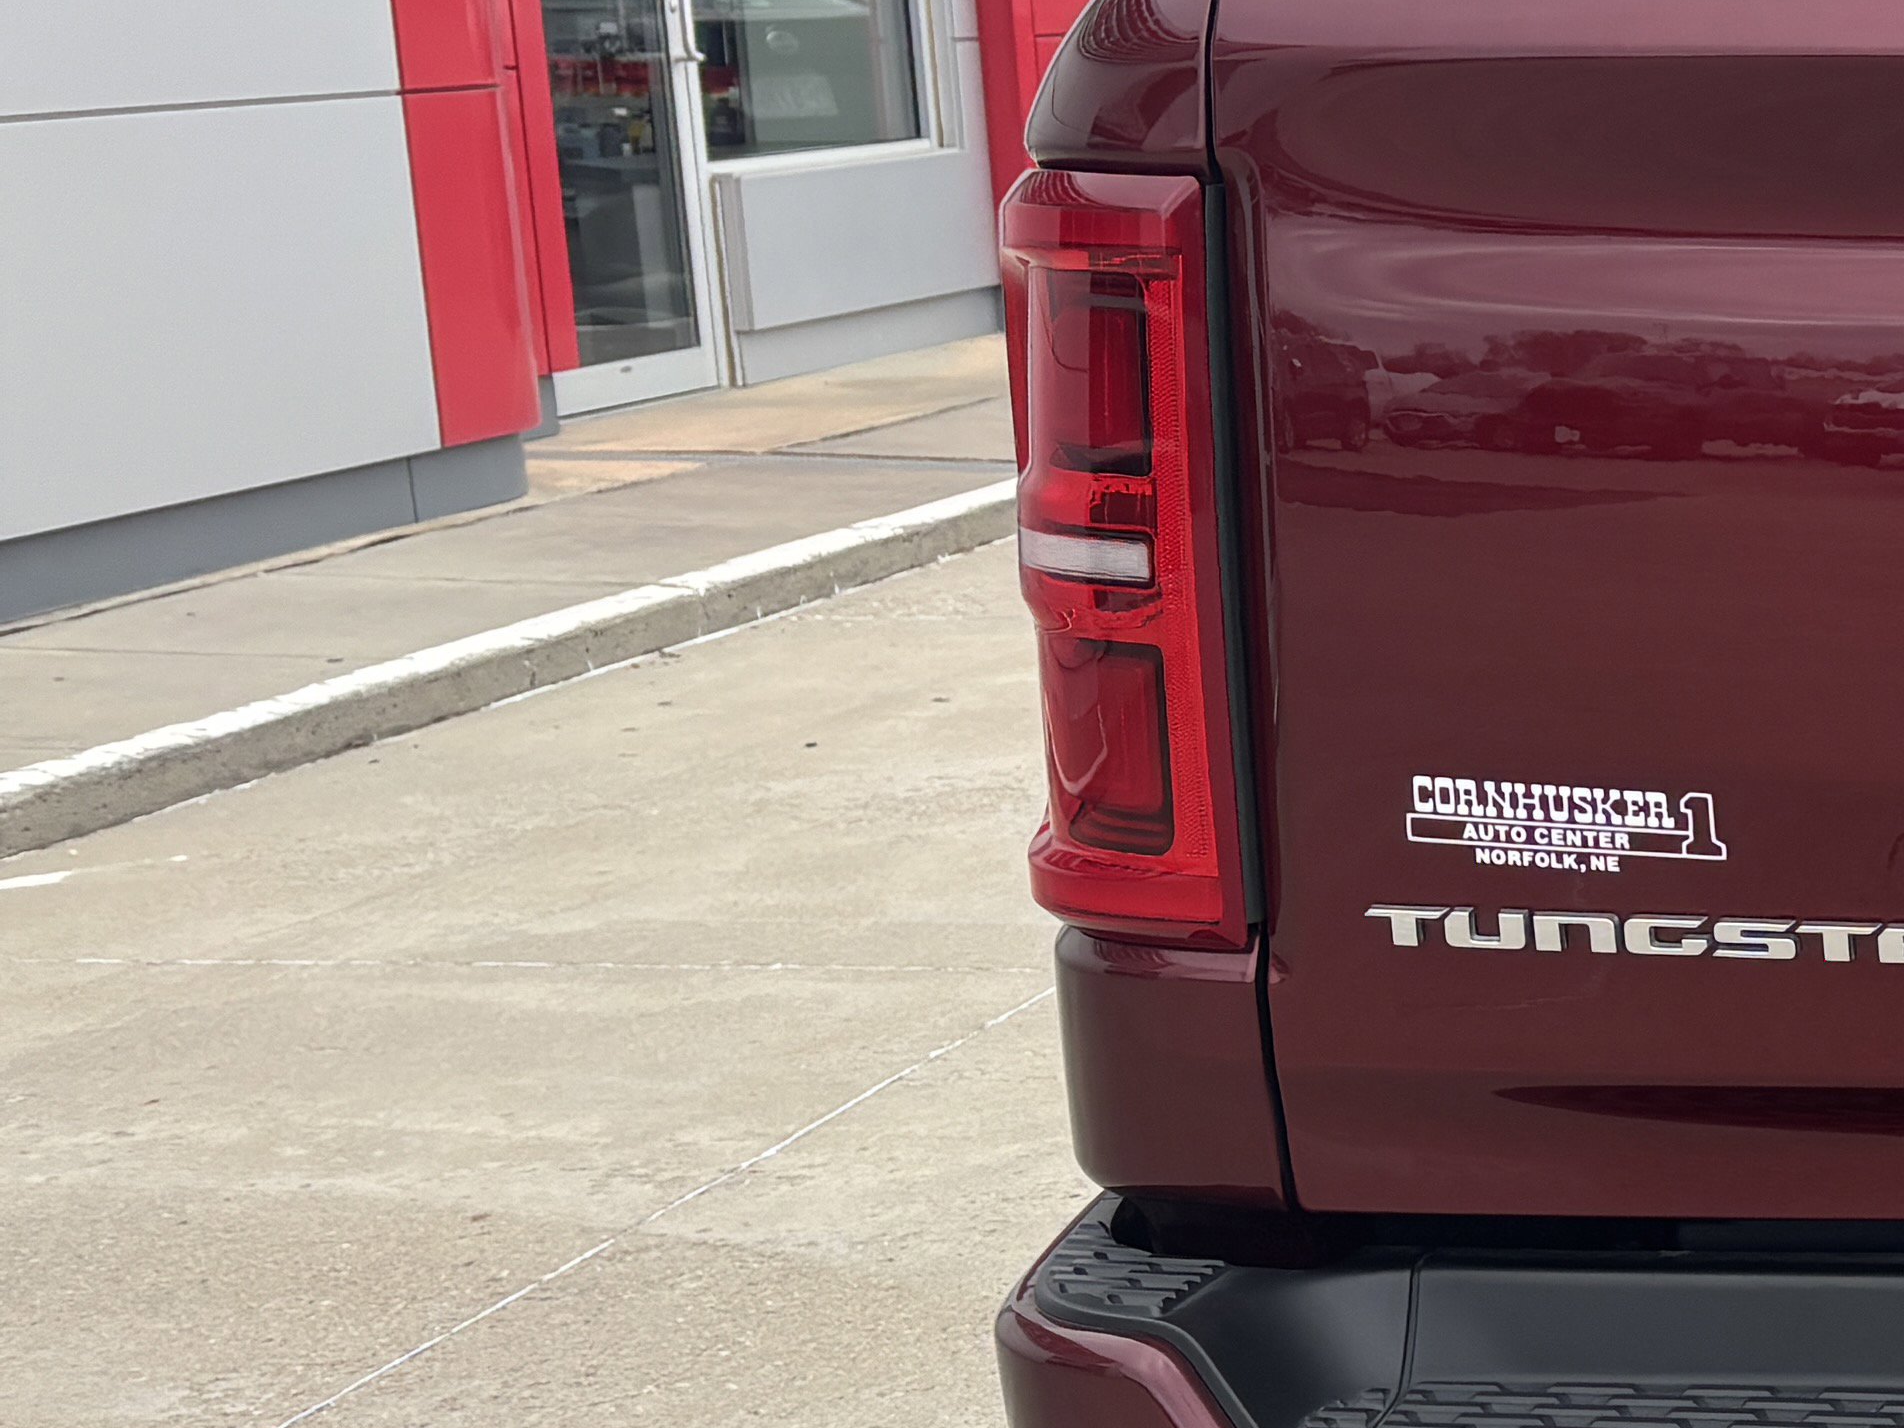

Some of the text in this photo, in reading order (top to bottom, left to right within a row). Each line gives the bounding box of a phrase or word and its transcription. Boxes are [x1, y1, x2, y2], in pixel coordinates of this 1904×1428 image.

[1411, 775, 1676, 829] CORNHUSKER
[1462, 822, 1631, 849] AUTO CENTER
